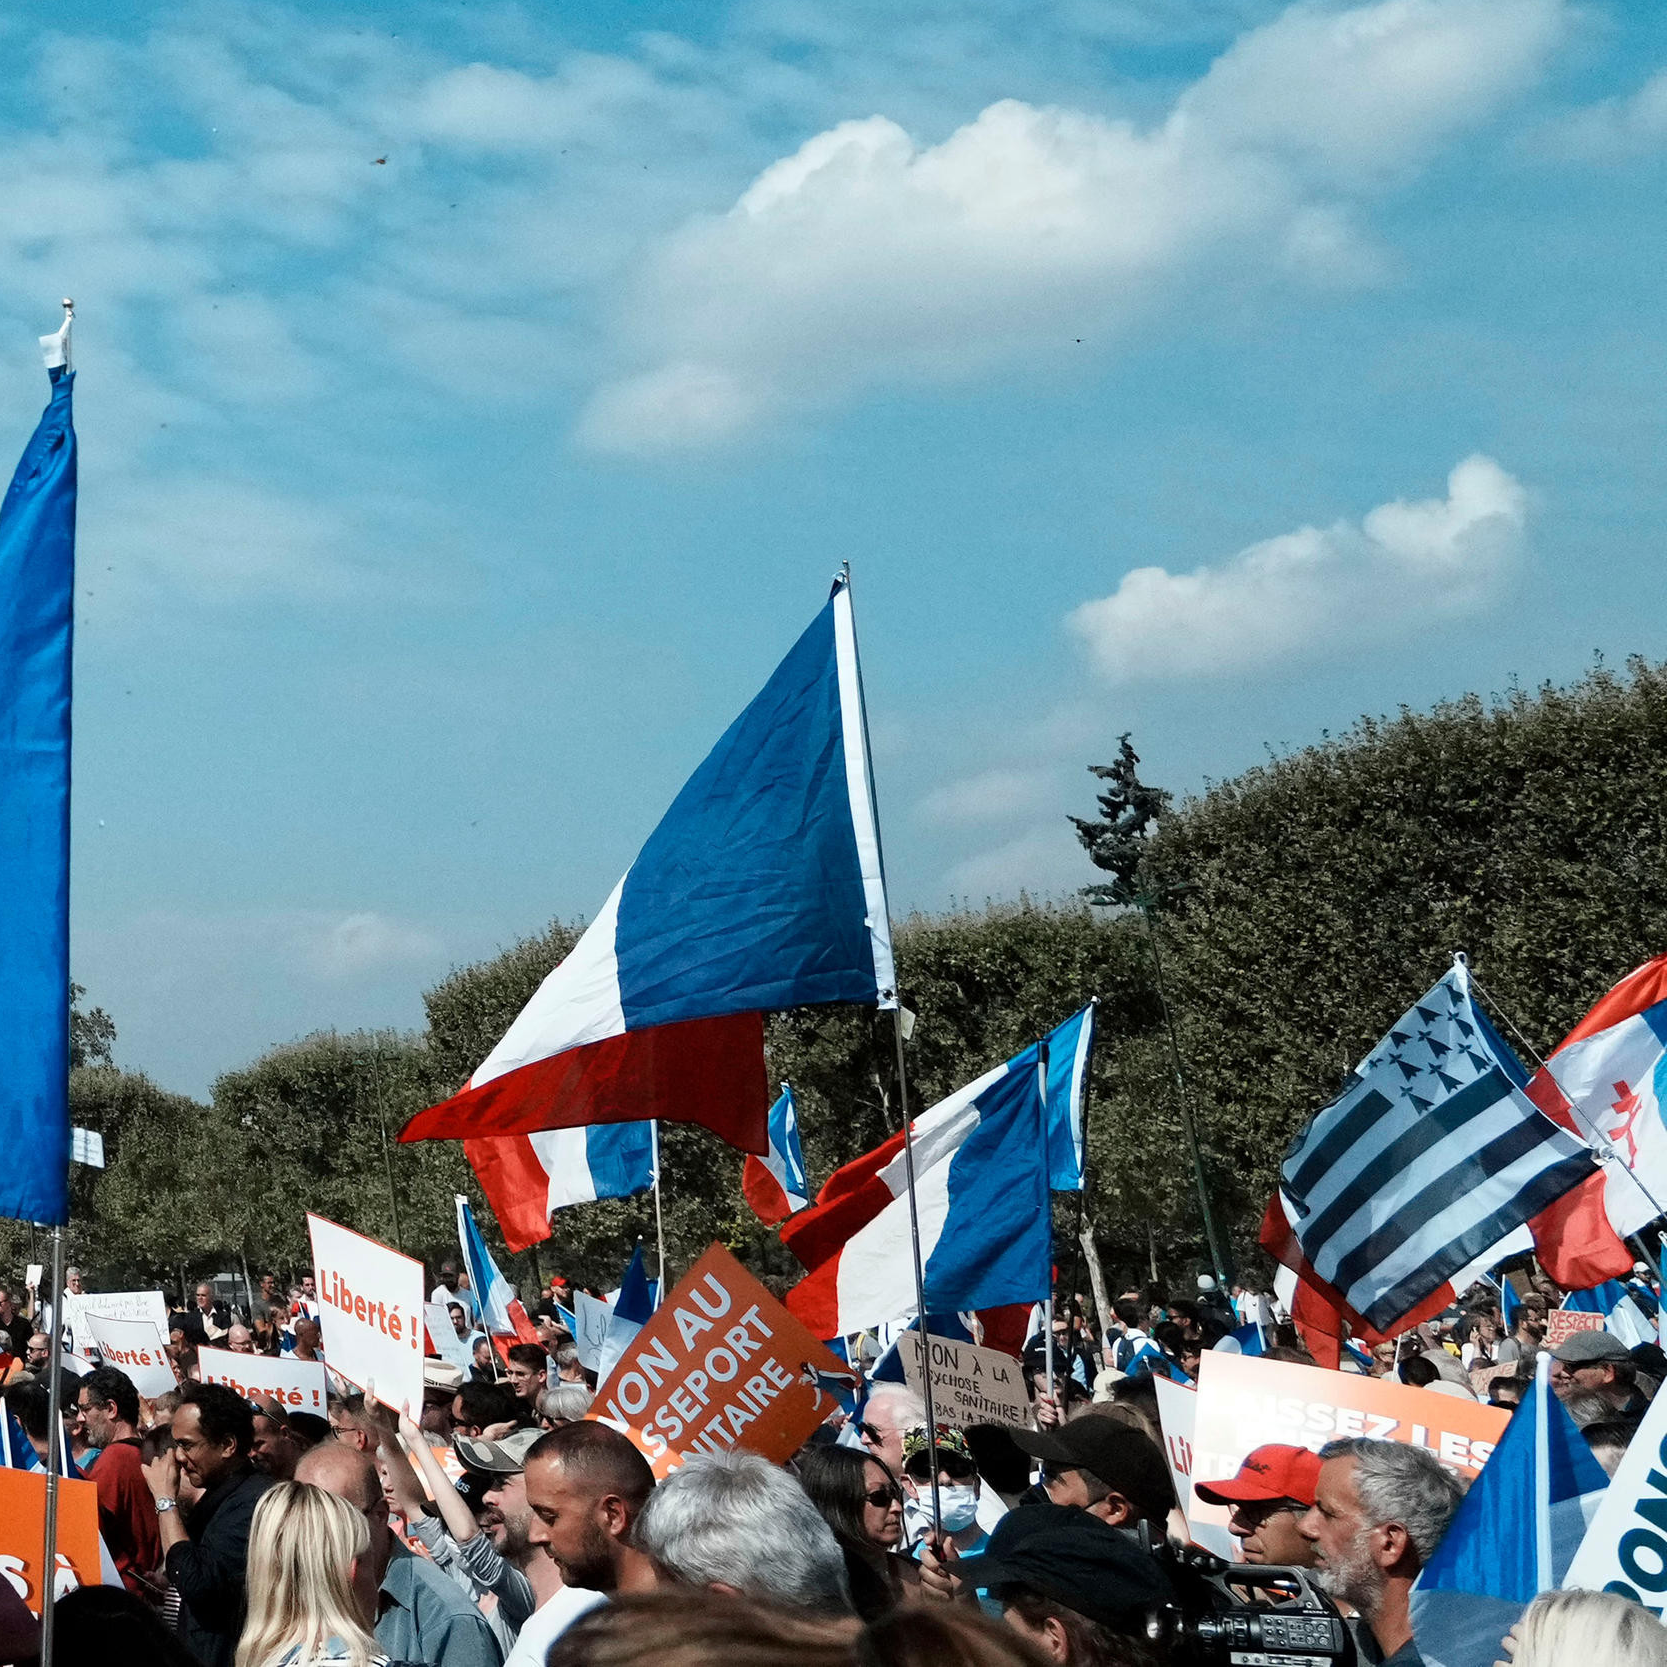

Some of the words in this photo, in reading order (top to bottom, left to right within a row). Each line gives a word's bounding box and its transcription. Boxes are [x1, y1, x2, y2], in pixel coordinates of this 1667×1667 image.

[320, 1269, 403, 1341] Liberté
[410, 1316, 418, 1349] !
[672, 1272, 732, 1352] AU
[1550, 1311, 1604, 1331] RESPECT
[98, 1340, 152, 1366] Liberté
[154, 1349, 165, 1366] !
[914, 1338, 959, 1370] NON
[972, 1355, 984, 1376] À
[992, 1367, 1010, 1384] LA
[312, 1390, 320, 1407] !
[640, 1304, 774, 1465] SSEPORT
[962, 1411, 975, 1423] LA
[1411, 1423, 1496, 1471] LES
